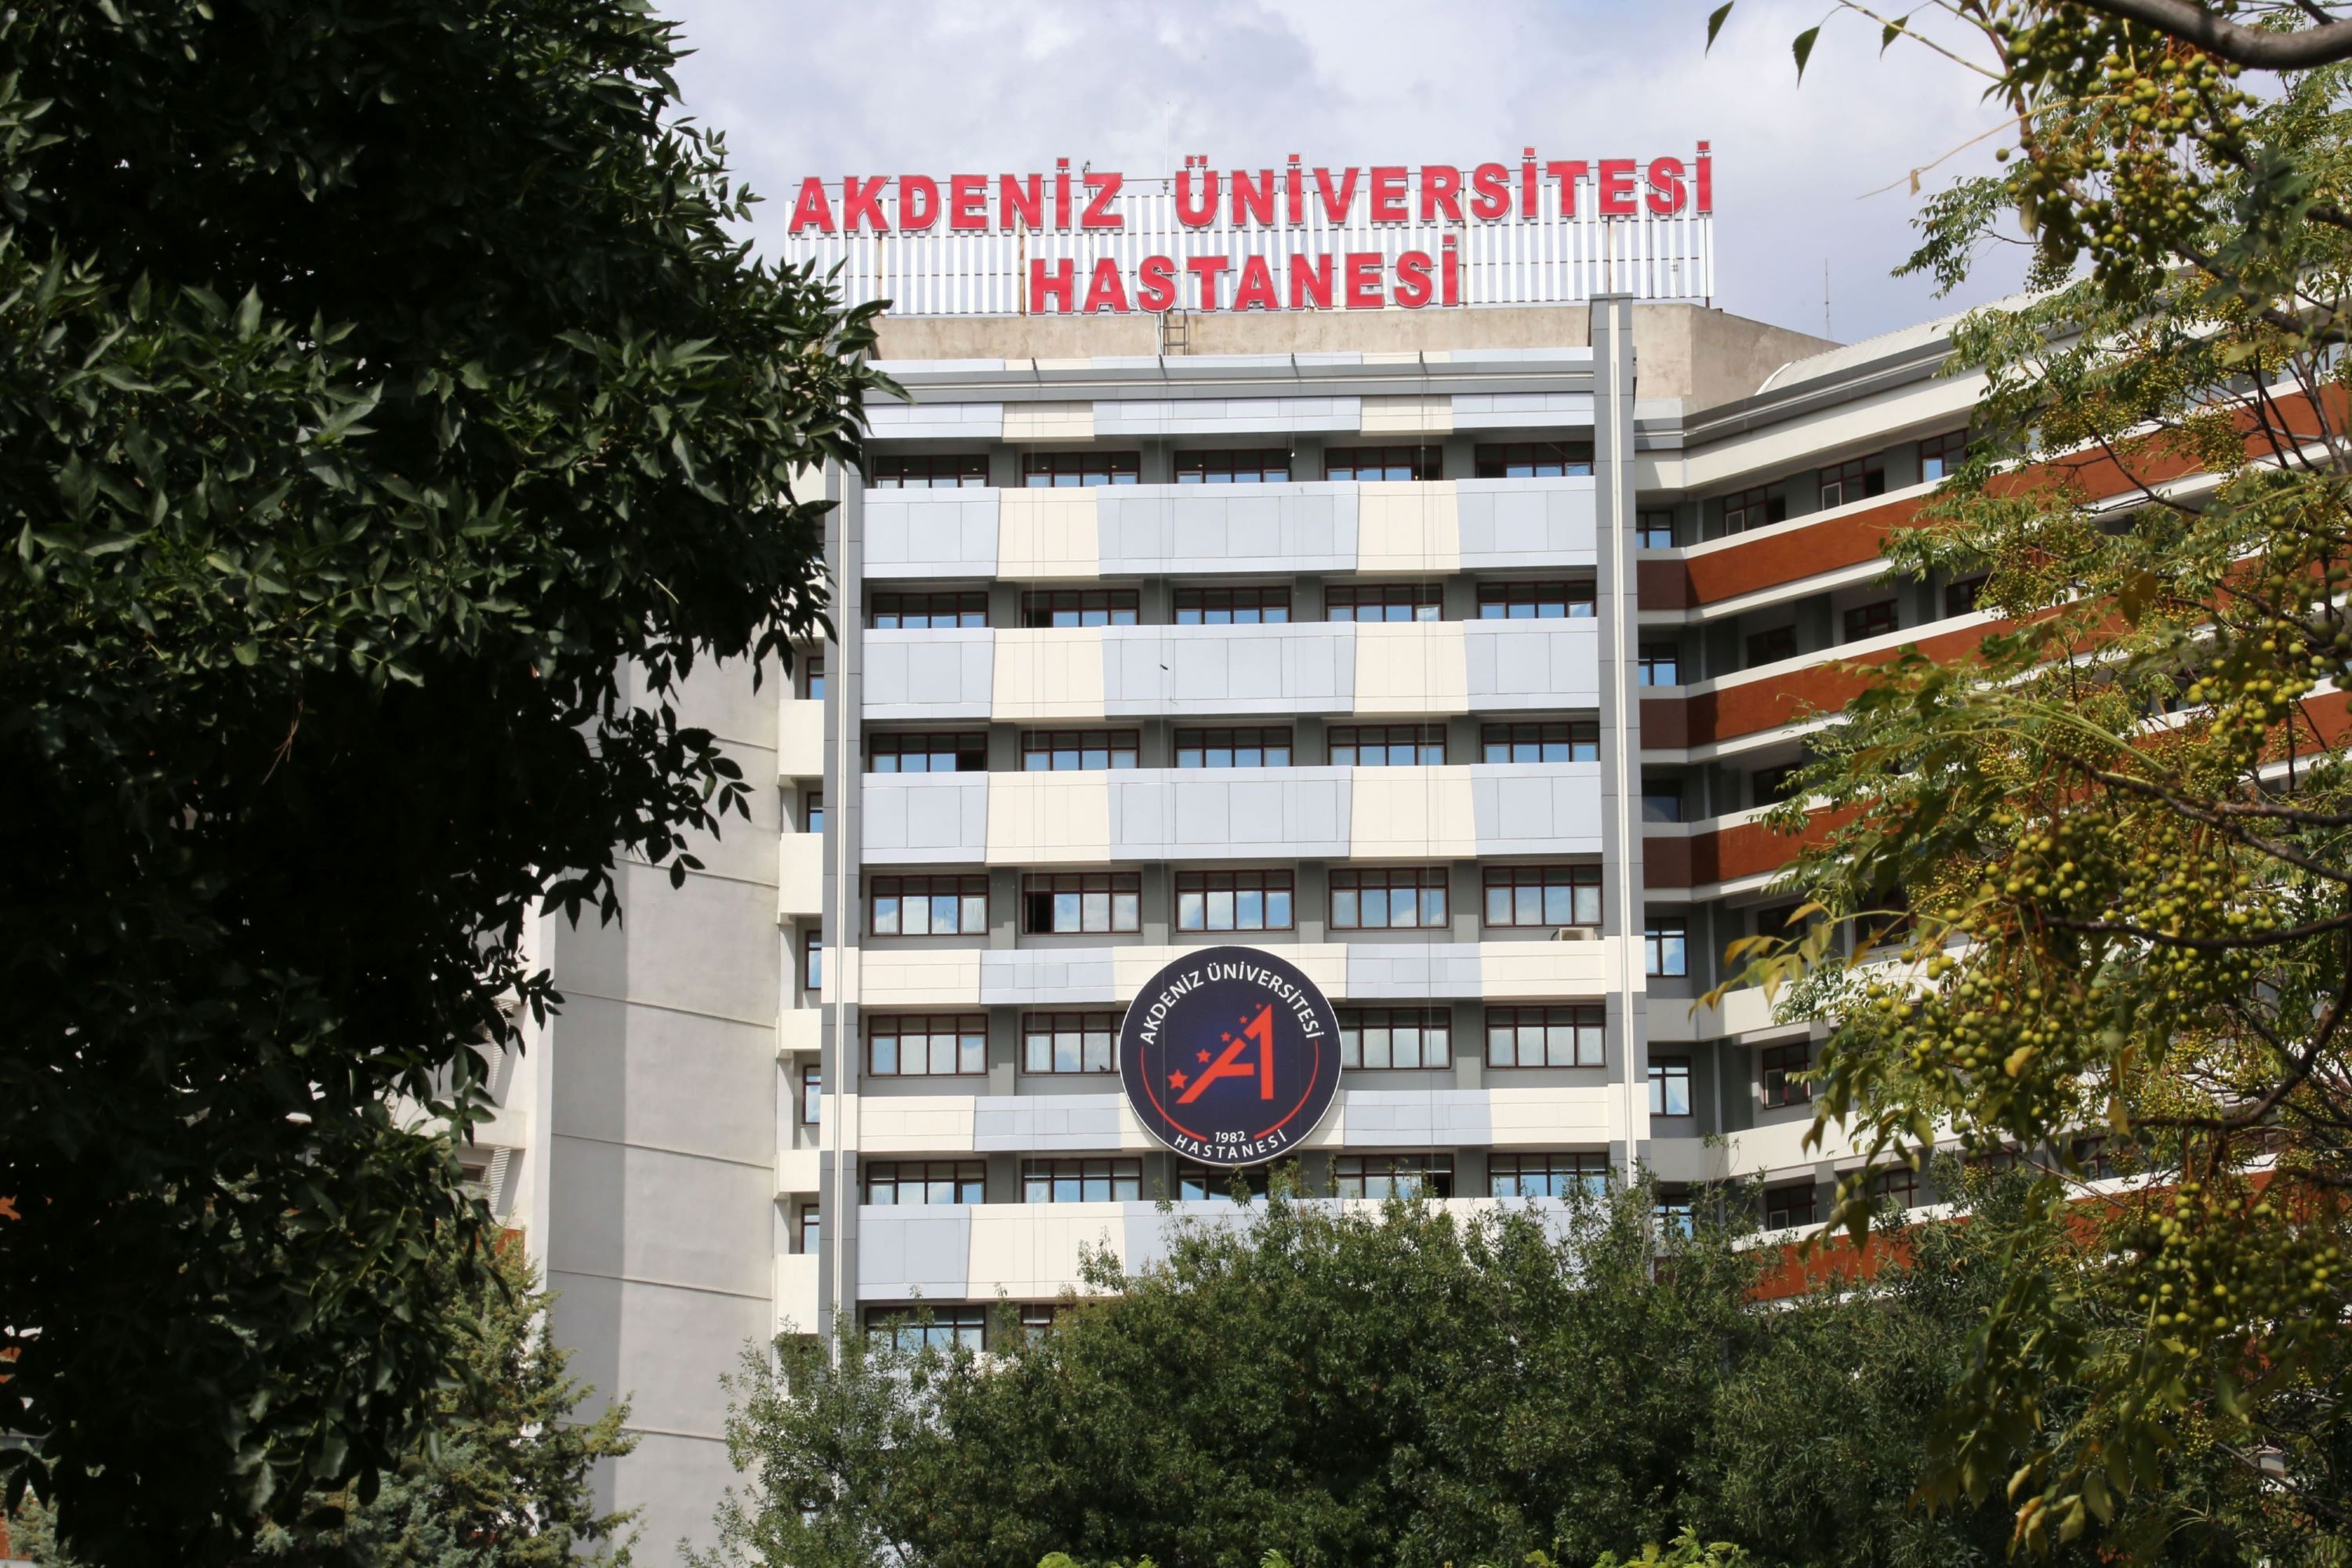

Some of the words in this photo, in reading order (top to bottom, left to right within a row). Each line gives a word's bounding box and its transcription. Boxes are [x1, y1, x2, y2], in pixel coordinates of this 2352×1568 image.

[788, 157, 1124, 234] AKDENİZ
[1174, 140, 1712, 227] ÜNİVERSİTESİ
[1029, 234, 1459, 314] HASTANESİ
[1140, 971, 1204, 1045] AKDENİZ
[1207, 961, 1325, 1040] ÜNİVERSİTESİ
[1174, 1128, 1287, 1160] HASTANESİ
[1214, 1131, 1247, 1143] 1982
